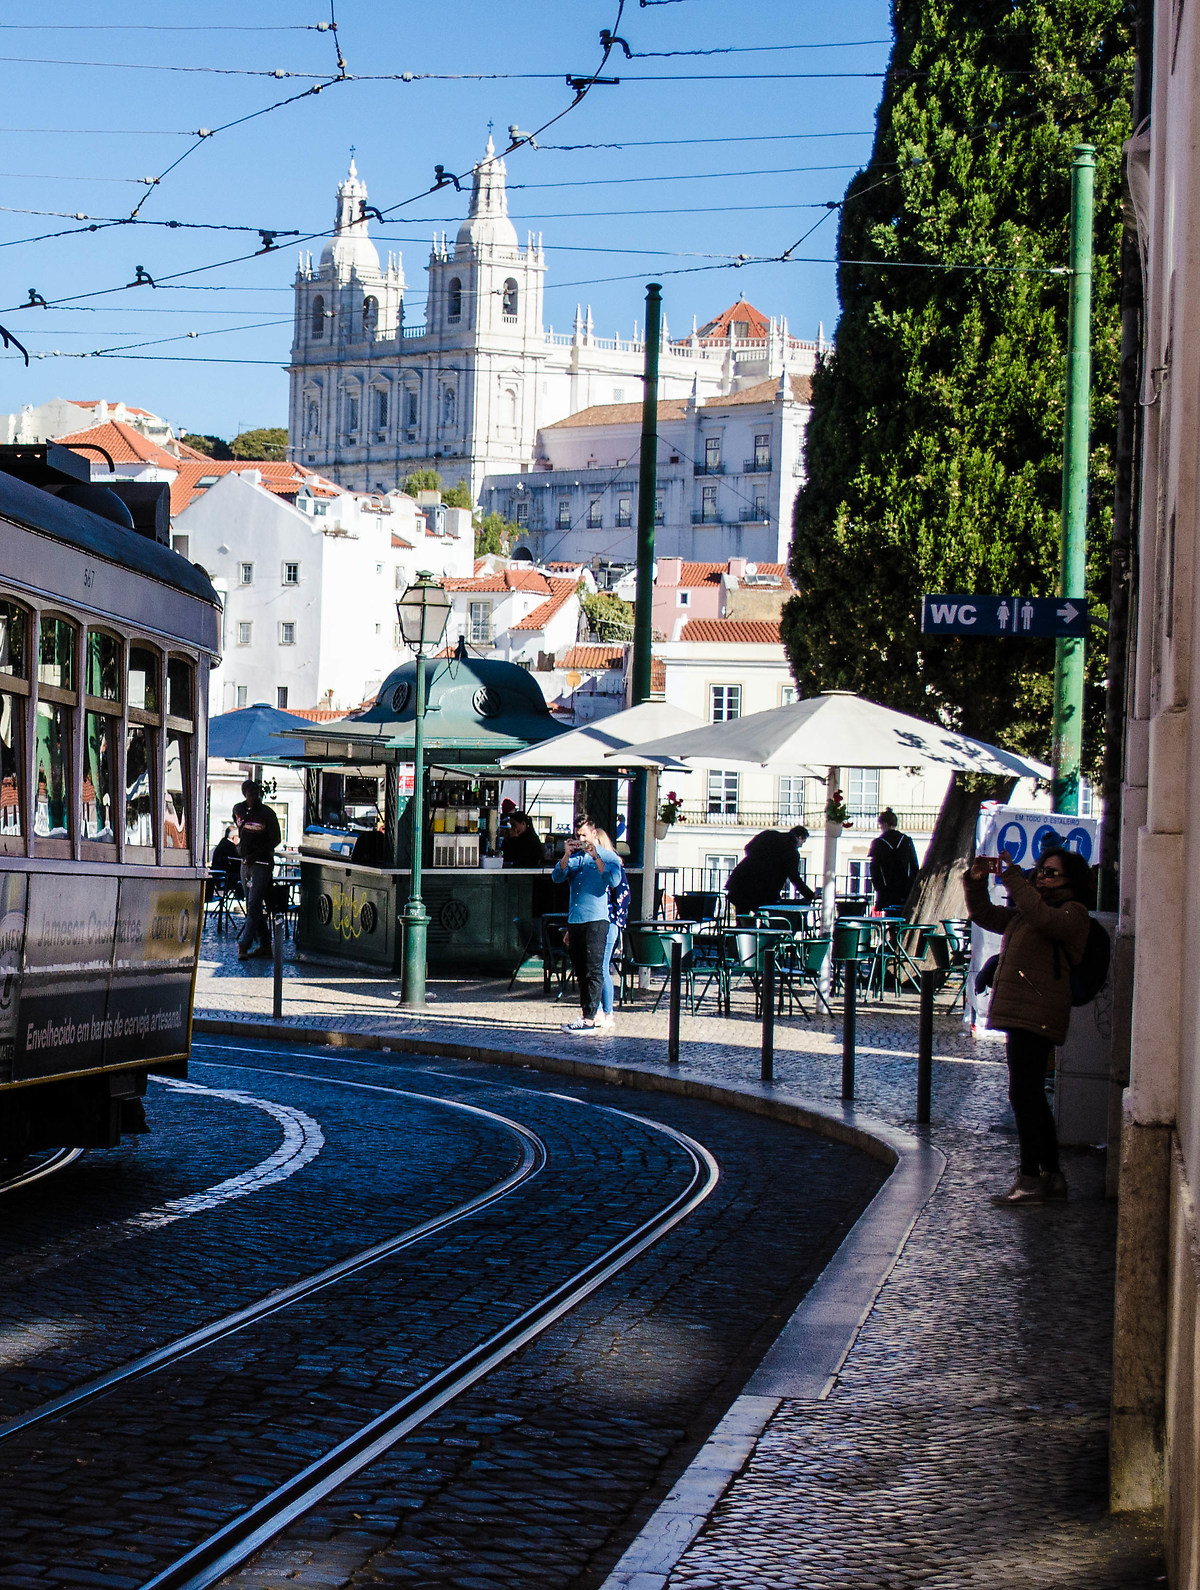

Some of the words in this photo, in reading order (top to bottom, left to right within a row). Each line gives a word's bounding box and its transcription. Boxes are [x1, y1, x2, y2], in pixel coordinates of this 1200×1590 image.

[84, 568, 95, 588] 567
[931, 604, 977, 625] WC
[1026, 815, 1041, 823] TODO
[1043, 816, 1048, 824] O
[1050, 817, 1080, 826] ESTALEIRO
[37, 912, 85, 947] Jameson
[26, 1017, 76, 1051] Envelhecido
[76, 1023, 90, 1043] em
[91, 1012, 112, 1040] barris
[113, 1011, 123, 1037] de
[124, 1008, 149, 1040] cerveja
